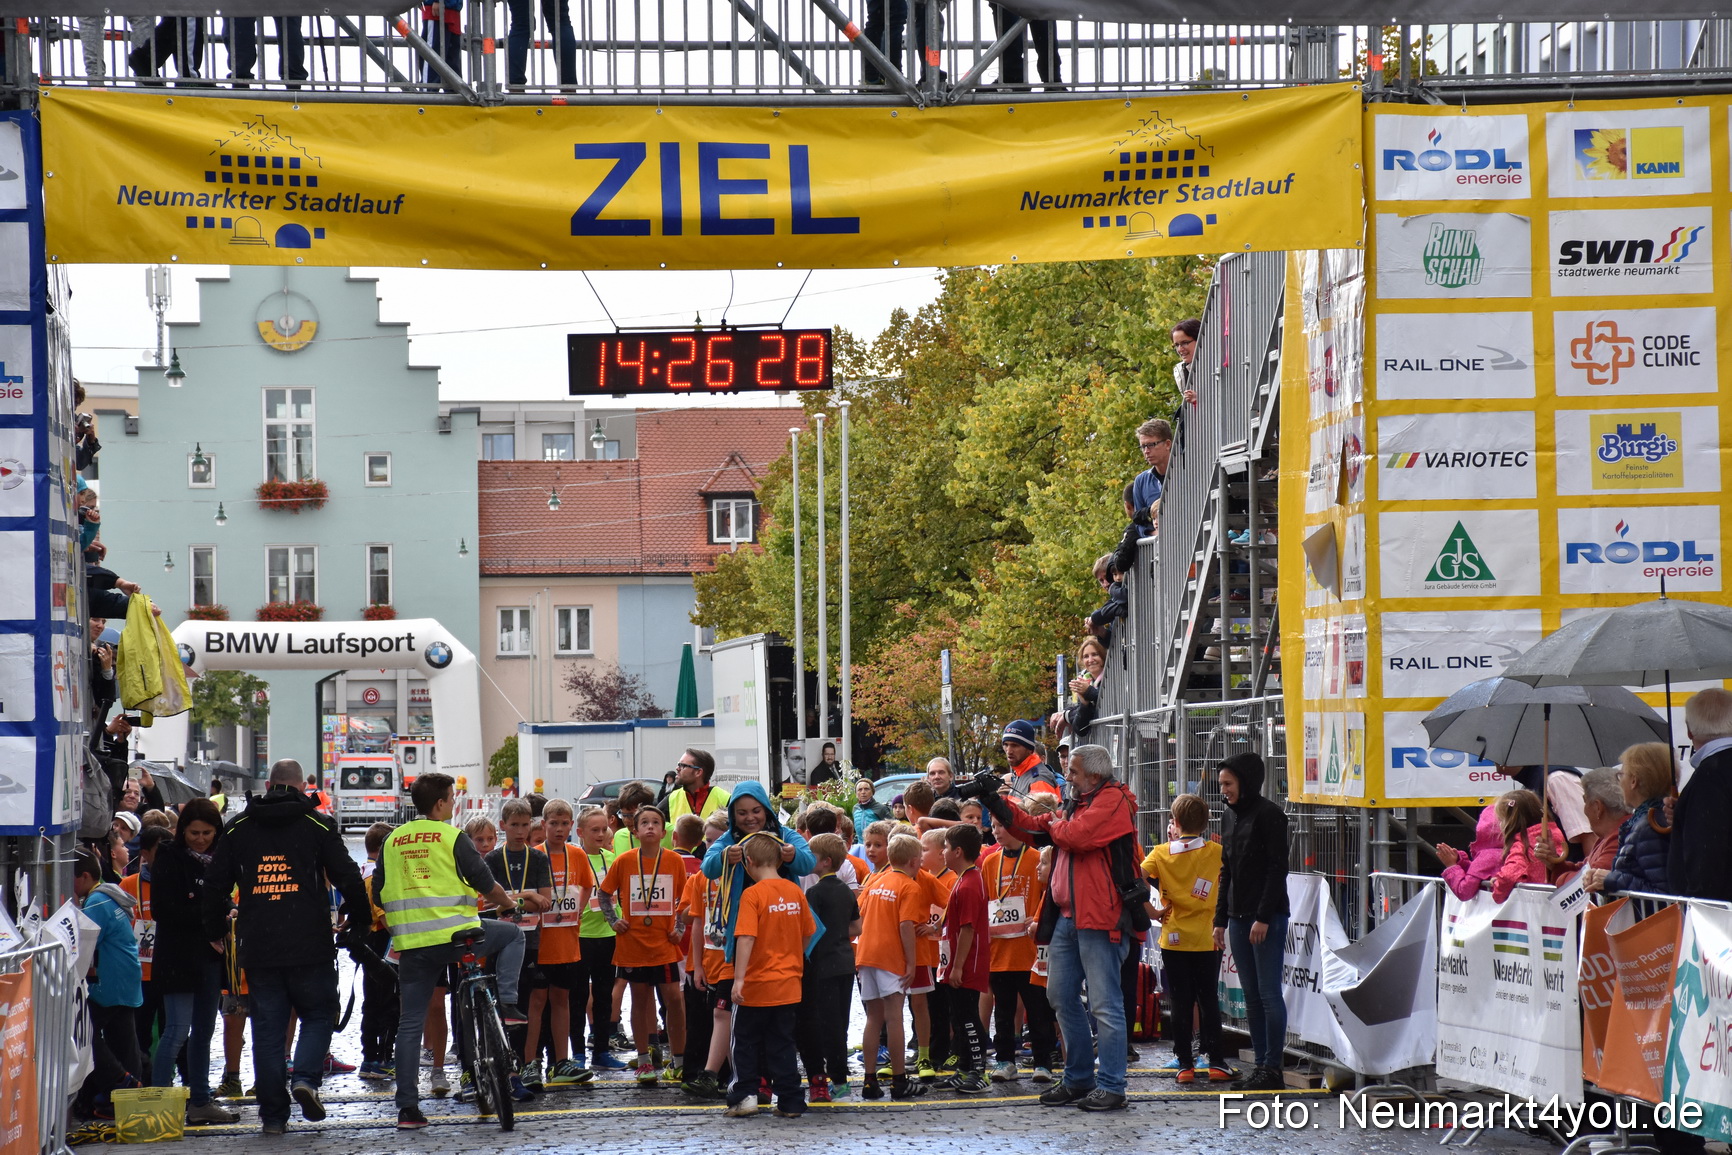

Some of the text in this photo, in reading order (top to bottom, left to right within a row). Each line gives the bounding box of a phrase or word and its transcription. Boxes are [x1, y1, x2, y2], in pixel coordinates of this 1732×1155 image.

[1456, 168, 1523, 185] energie
[1636, 162, 1681, 175] KANN
[570, 141, 860, 237] ZIEL
[1019, 172, 1295, 212] Neumarkter Stadtlauf
[116, 184, 405, 217] Neumarkter Stadtlauf
[1426, 222, 1477, 258] RUND
[1558, 238, 1655, 265] swn
[1424, 257, 1485, 286] SCHAU
[1557, 265, 1681, 278] stadtwerke neumarkt
[1642, 334, 1691, 351] CODE
[600, 334, 825, 388] 14:26 28
[1643, 351, 1701, 368] CLINIC
[1597, 433, 1679, 464] Burgis
[1424, 451, 1529, 469] VARIOTEC
[1625, 463, 1649, 472] Feinste
[1602, 471, 1674, 482] Kartoffelspezialitäten
[1643, 561, 1714, 577] energie
[205, 631, 416, 658] BMW Laufsport
[392, 832, 442, 847] HELFER
[257, 863, 292, 873] FOTO-
[257, 874, 292, 883] TEAM-
[252, 884, 299, 895] MUELLER
[1559, 887, 1584, 910] swn
